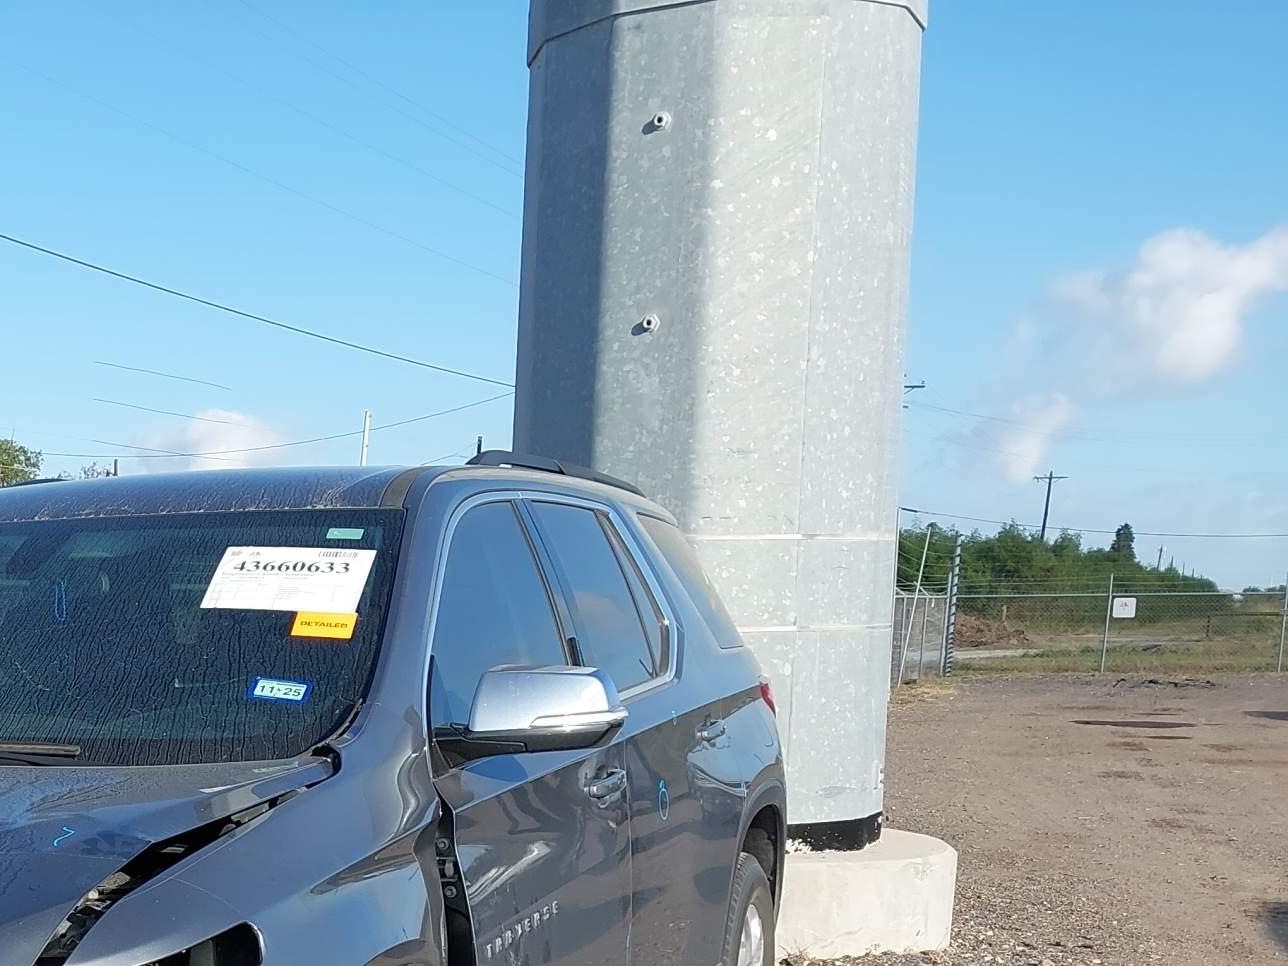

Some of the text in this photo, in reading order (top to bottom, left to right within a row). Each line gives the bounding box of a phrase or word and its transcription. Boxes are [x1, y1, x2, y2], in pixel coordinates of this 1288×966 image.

[233, 560, 351, 574] 43660633
[299, 620, 348, 629] DETAILED
[484, 900, 560, 959] TRAVERSE
